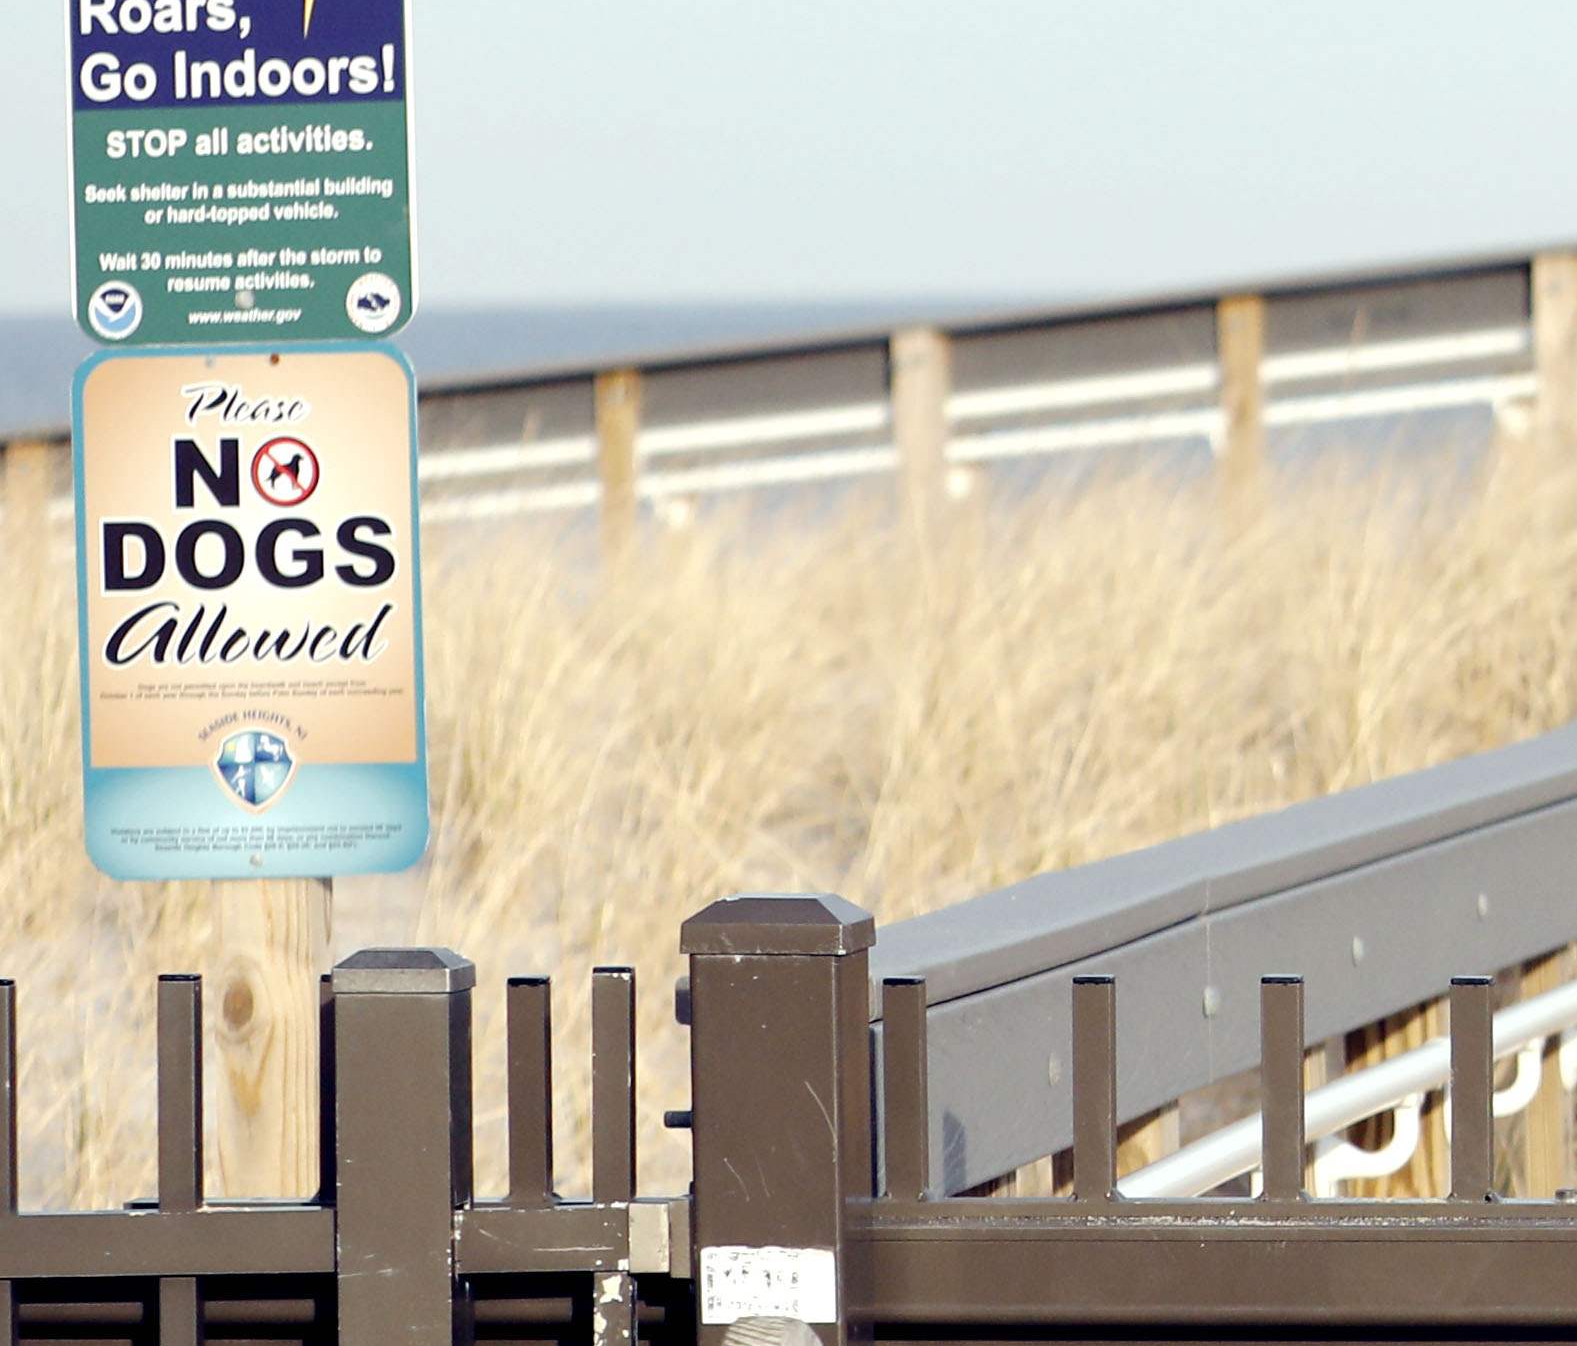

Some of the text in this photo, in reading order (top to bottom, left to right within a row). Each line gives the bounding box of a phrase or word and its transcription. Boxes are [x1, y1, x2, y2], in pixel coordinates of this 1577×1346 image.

[80, 43, 395, 102] Go Indoors!
[106, 124, 374, 159] STOP all activities.
[85, 176, 393, 203] Seek shelter in a substantial building
[144, 201, 339, 226] or hard-topped vehicle.
[99, 245, 382, 271] Wait 30 minutes after the storm to
[167, 270, 315, 292] resume activities.
[188, 307, 302, 325] www.weather.gov
[185, 385, 307, 423] Please
[103, 516, 396, 591] DOGS
[105, 601, 393, 666] Allowed
